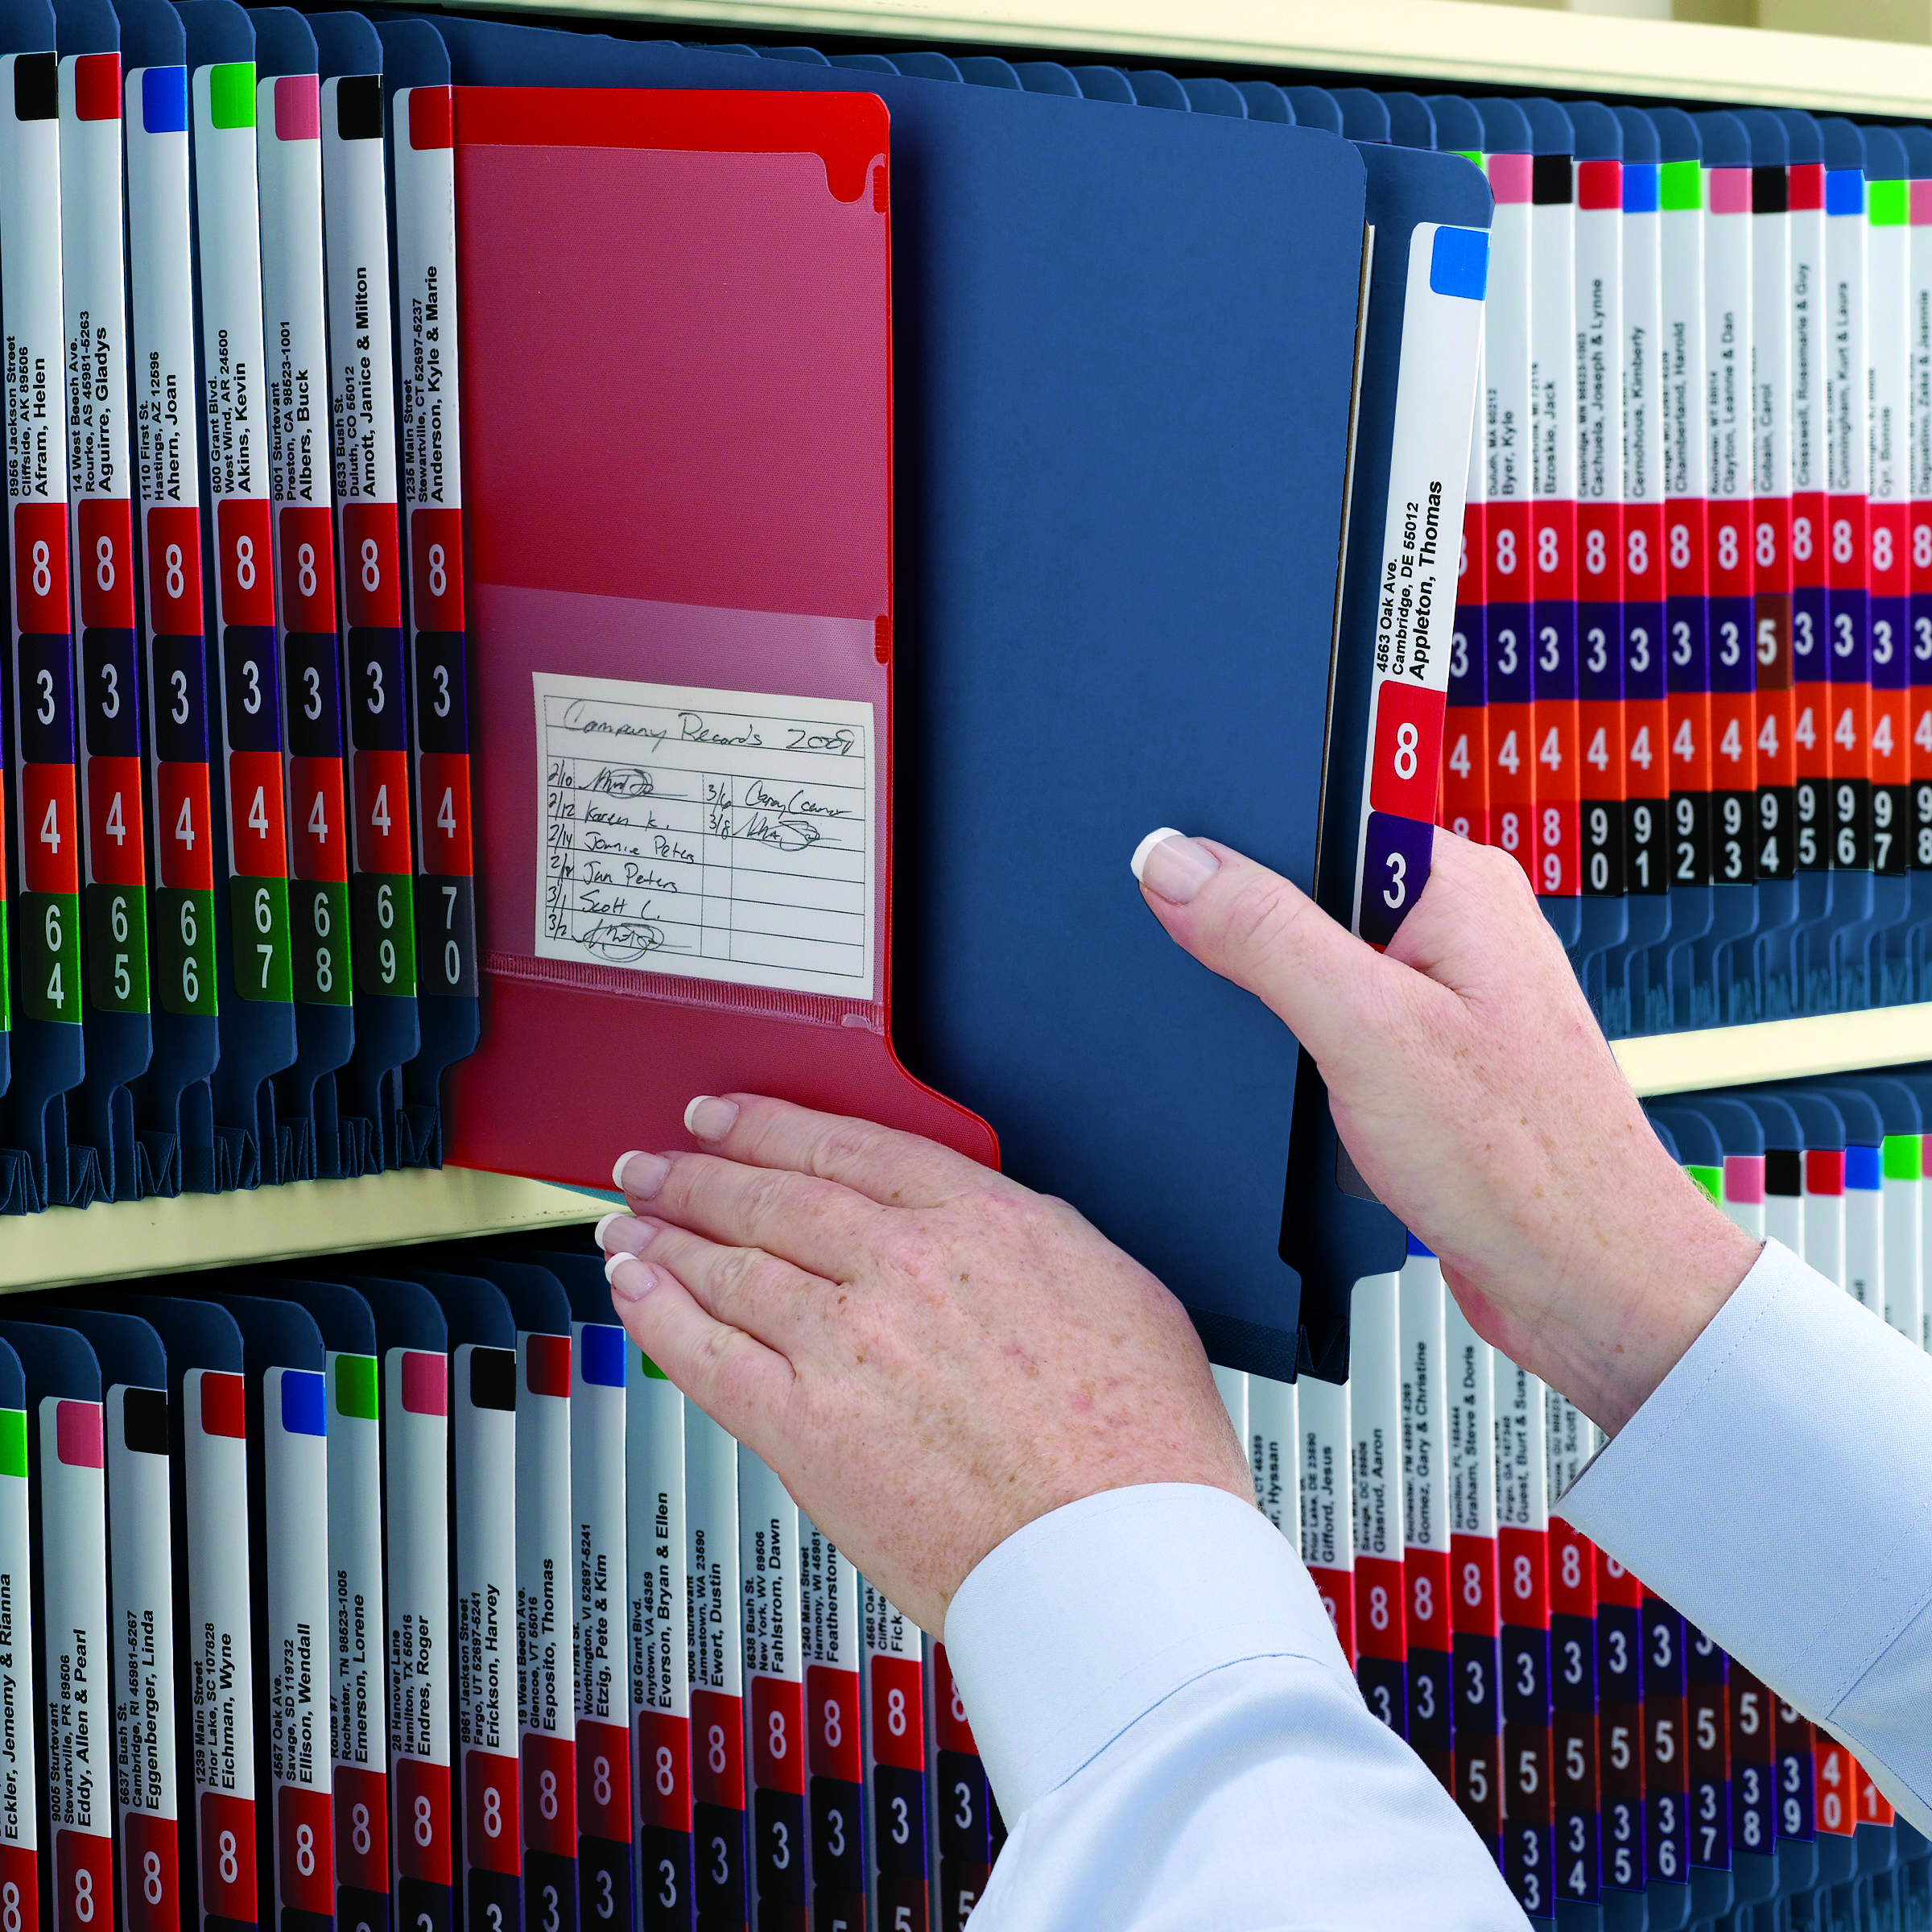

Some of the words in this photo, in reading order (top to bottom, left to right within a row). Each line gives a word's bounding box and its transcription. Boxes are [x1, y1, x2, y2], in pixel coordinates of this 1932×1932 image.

[355, 267, 369, 329] Milton
[425, 266, 438, 321] Marie
[1590, 279, 1606, 329] Lynne
[6, 336, 16, 383] Street
[68, 338, 78, 373] Ave.
[80, 311, 92, 400] 45981-5263
[357, 335, 369, 350] &
[412, 298, 424, 382] 52697-5237
[426, 327, 439, 342] &
[1591, 335, 1602, 345] &
[19, 346, 29, 394] 89506
[32, 358, 46, 418] Helen
[94, 327, 110, 401] Gladys
[149, 351, 160, 397] 12596
[358, 357, 373, 423] Janice
[427, 348, 443, 392] Kyle
[1591, 351, 1605, 411] Joseph
[19, 398, 30, 422] AK
[69, 377, 80, 426] Beach
[83, 404, 93, 427] AS
[138, 400, 149, 420] St.
[151, 401, 161, 423] AZ
[164, 374, 178, 426] Joan
[233, 363, 247, 421] Kevin
[295, 369, 310, 422] Buck
[403, 378, 414, 423] Street
[415, 386, 424, 407] CT
[1544, 382, 1556, 419] Jack
[7, 388, 19, 455] Jackson
[140, 424, 151, 460] First
[404, 428, 415, 464] Main
[1501, 411, 1517, 447] Kyle
[21, 427, 31, 497] Cliffside,
[35, 426, 48, 497] Afram,
[72, 430, 81, 470] West
[84, 432, 95, 492] Rourke,
[97, 408, 114, 493] Aguirre,
[153, 428, 164, 501] Hastings,
[167, 432, 180, 502] Ahern,
[237, 428, 251, 493] Akins,
[299, 429, 312, 502] Albers,
[361, 430, 376, 497] Amott,
[416, 411, 428, 503] Stewartville,
[430, 399, 444, 503] Anderson,
[1501, 452, 1517, 496] Byer,
[9, 459, 19, 497] 8956
[72, 473, 82, 492] 14
[141, 464, 151, 501] 1110
[406, 469, 416, 502] 1235
[1403, 502, 1418, 550] 55012
[1418, 481, 1442, 567] Thomas
[1383, 559, 1397, 594] Ave.
[1401, 554, 1414, 578] DE
[1380, 597, 1393, 630] Oak
[1392, 584, 1414, 675] Cambridge,
[1408, 576, 1436, 681] Appleton,
[1377, 634, 1390, 673] 4563
[564, 699, 667, 753] Company
[678, 712, 762, 746] Records
[1394, 723, 1418, 779] 8
[1383, 852, 1406, 909] 3
[1415, 1341, 1427, 1416] Christine
[1372, 1429, 1383, 1479] Aaron
[1416, 1422, 1427, 1433] &
[1321, 1446, 1333, 1496] Jesus
[1416, 1438, 1431, 1478] Gary
[655, 1492, 668, 1539] Ellen
[1321, 1501, 1335, 1563] Gifford,
[1373, 1484, 1386, 1554] Glasrud,
[1418, 1483, 1431, 1545] Gomez,
[656, 1545, 668, 1558] &
[769, 1518, 781, 1570] Dawn
[541, 1558, 554, 1635] Thomas
[594, 1554, 607, 1591] Kim
[657, 1564, 672, 1620] Bryan
[708, 1563, 722, 1623] Dustin
[0, 1574, 12, 1646] Rianna
[353, 1594, 365, 1663] Lorene
[485, 1583, 500, 1651] Harvey
[594, 1598, 607, 1612] &
[770, 1576, 784, 1674] Fahlstrom,
[825, 1542, 839, 1662] Featherstone
[73, 1629, 87, 1682] Pearl
[141, 1610, 155, 1666] Linda
[204, 1622, 216, 1674] 107828
[416, 1615, 431, 1675] Roger
[471, 1591, 481, 1672] 52697-5241
[595, 1617, 608, 1659] Pete
[0, 1653, 12, 1668] &
[193, 1661, 204, 1706] Street
[219, 1633, 235, 1690] Wyne
[297, 1623, 311, 1703] Wendall
[658, 1627, 672, 1708] Everson,
[710, 1630, 724, 1687] Ewert,
[74, 1689, 88, 1704] &
[206, 1679, 217, 1702] SC
[472, 1678, 483, 1696] UT
[486, 1658, 500, 1748] Erickson,
[542, 1642, 558, 1731] Esposito,
[596, 1666, 612, 1718] Etzig,
[2, 1674, 16, 1763] Jememy
[76, 1711, 89, 1764] Allen
[144, 1674, 162, 1810] Eggenberger,
[195, 1711, 206, 1746] Main
[207, 1707, 218, 1746] Lake,
[354, 1670, 368, 1763] Emerson,
[417, 1682, 431, 1757] Endres,
[473, 1701, 485, 1745] Fargo,
[195, 1749, 206, 1784] 1239
[208, 1750, 219, 1788] Prior
[221, 1697, 235, 1790] Eichman,
[299, 1711, 313, 1784] Ellison,
[3, 1769, 19, 1839] Eckler,
[76, 1769, 93, 1827] Eddy,
